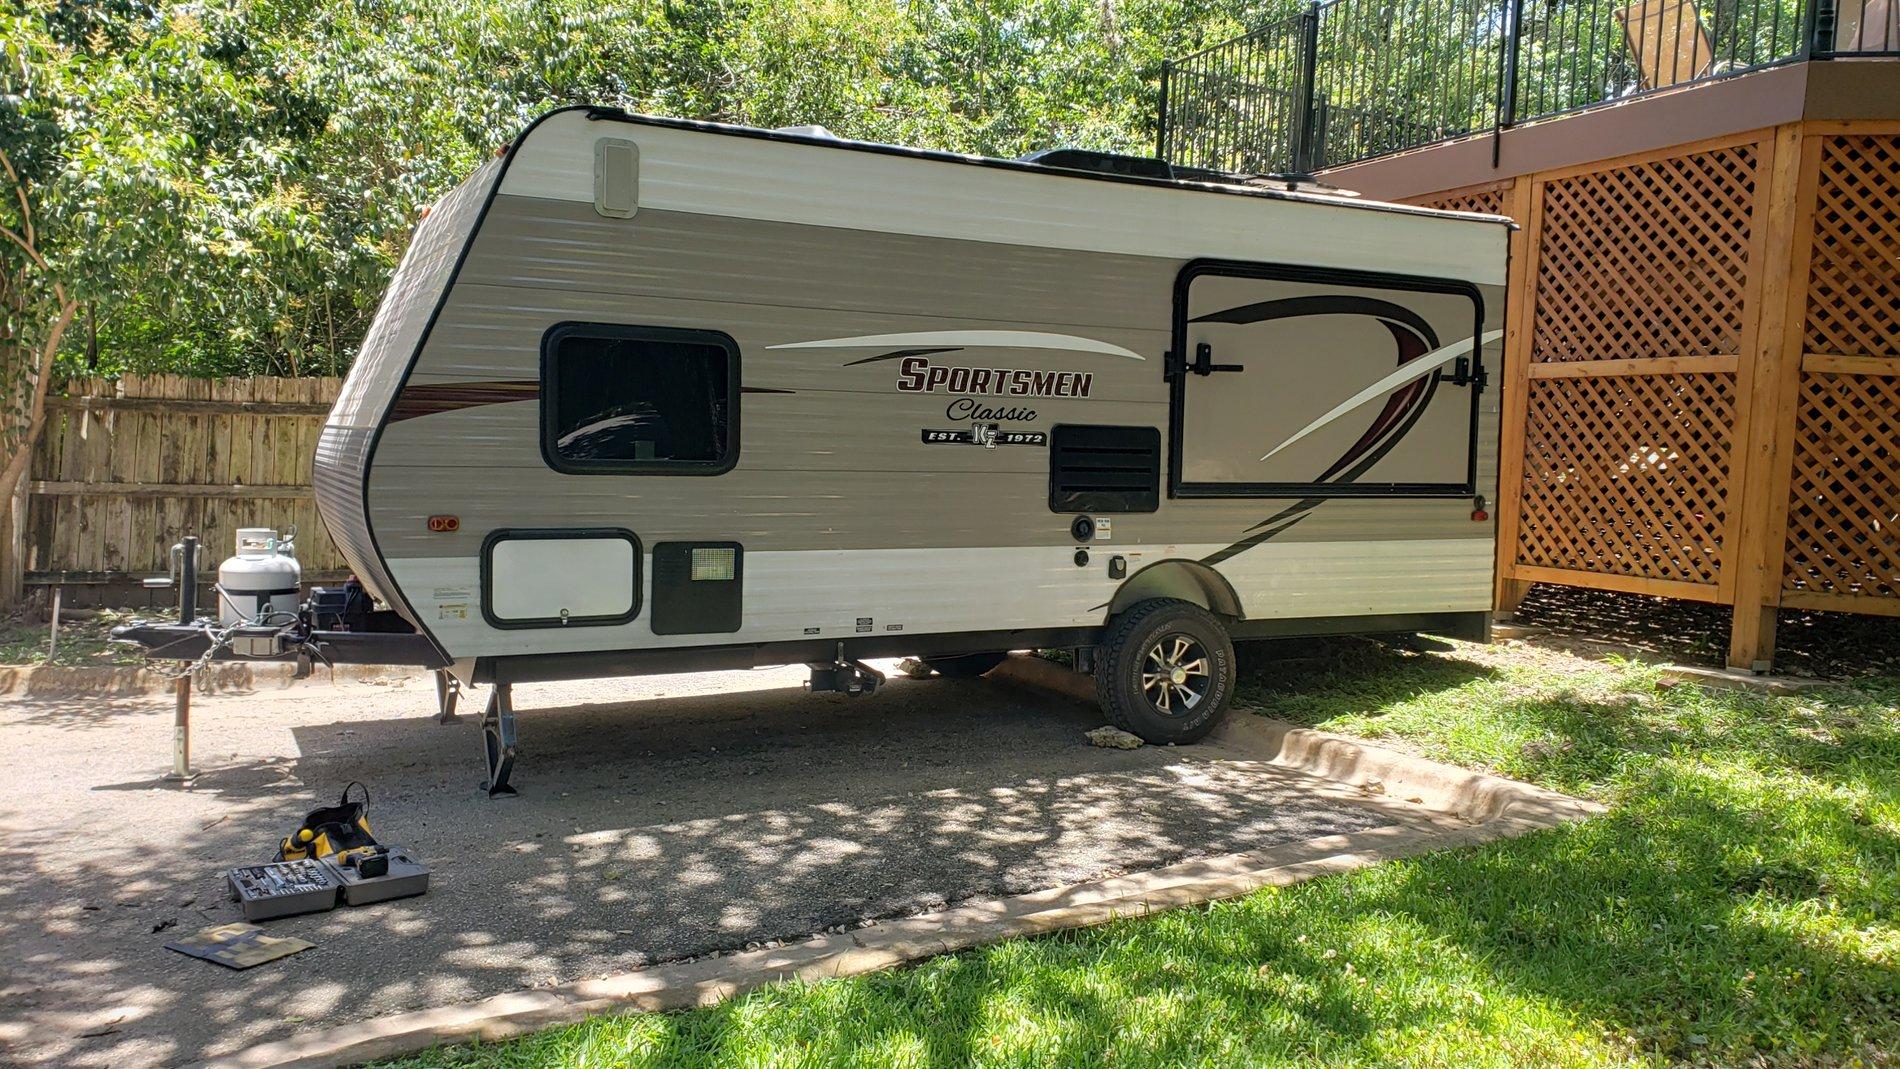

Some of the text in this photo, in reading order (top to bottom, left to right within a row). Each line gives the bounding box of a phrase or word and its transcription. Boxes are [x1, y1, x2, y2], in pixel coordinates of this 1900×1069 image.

[897, 357, 1093, 398] SPORTSMEN
[946, 398, 1037, 421] Classic
[928, 432, 961, 441] EST.
[1007, 434, 1043, 443] 1972
